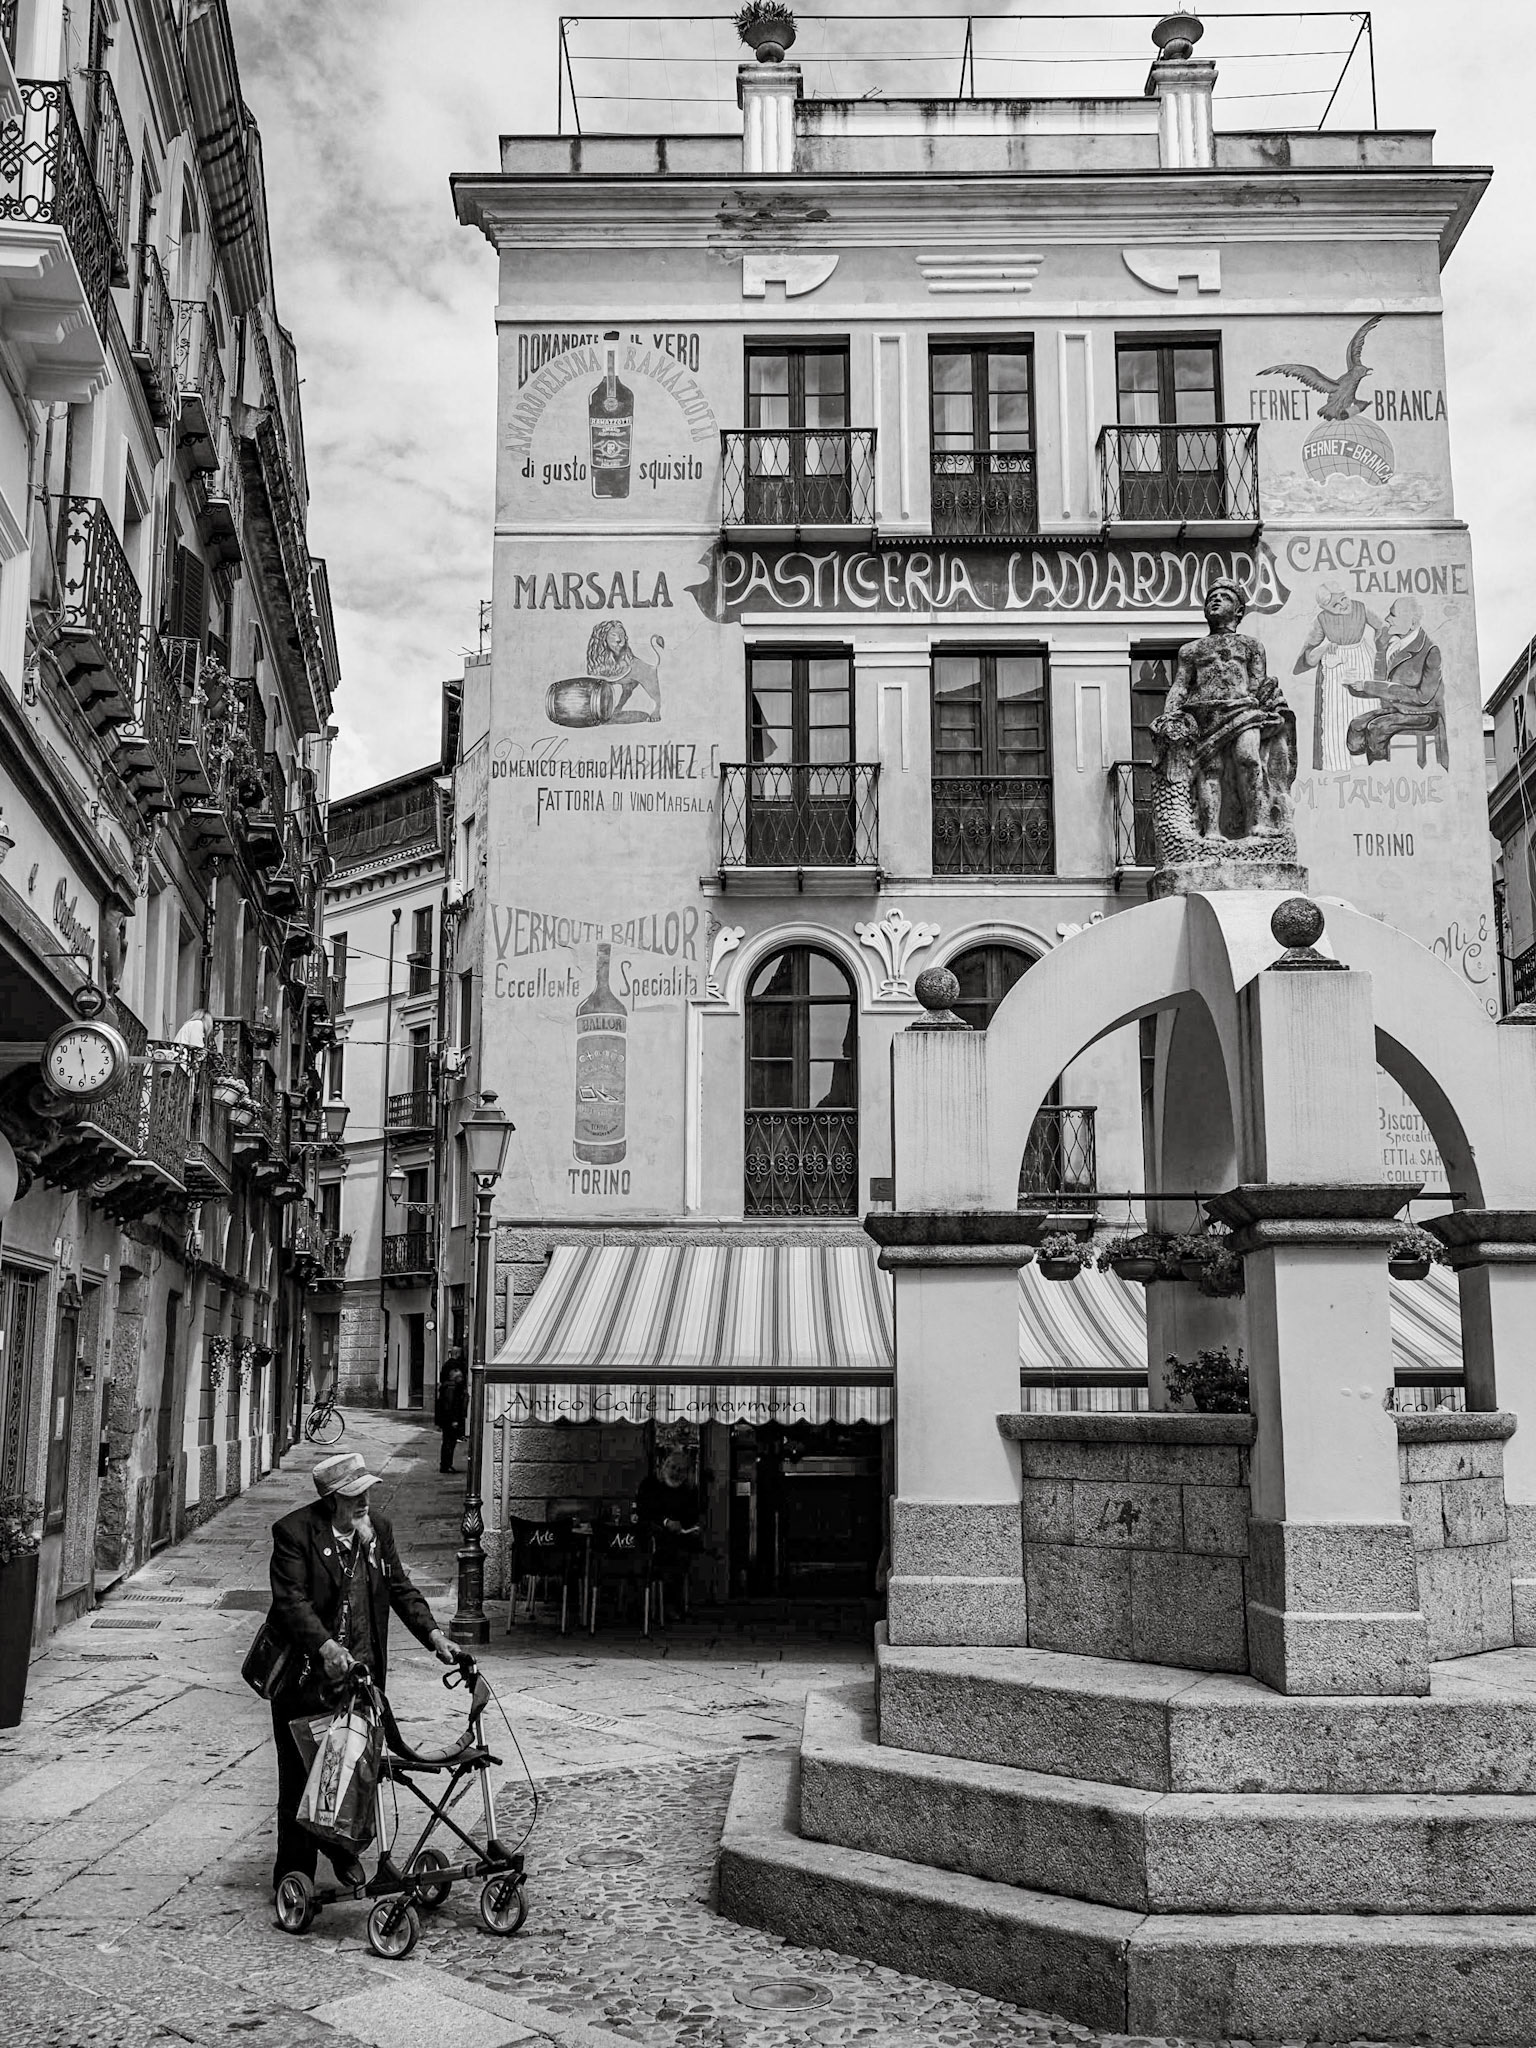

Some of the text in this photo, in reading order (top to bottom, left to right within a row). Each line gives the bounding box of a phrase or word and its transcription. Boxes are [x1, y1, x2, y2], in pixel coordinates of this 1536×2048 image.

[518, 333, 700, 390] DOMANDATE IL VERO
[505, 347, 602, 457] AMARO FELSINA
[623, 346, 719, 443] RAMAZZOTTI
[1250, 389, 1448, 422] FERNET BRANCA
[521, 454, 703, 489] di gusto squisito
[1303, 439, 1394, 483] FERNET-BRANCA
[1286, 535, 1396, 573] CACAO
[513, 570, 674, 610] MARSALA
[716, 550, 1285, 615] PASTICCERIA LAMARMORA
[1349, 563, 1469, 595] TALMONE
[492, 760, 556, 779] DOMENICO
[560, 761, 607, 779] FLORIO
[609, 744, 698, 780] MARTINEZ
[1333, 774, 1444, 810] TALMONE
[537, 787, 714, 827] FATTORIA DI VINO MARSALA
[1353, 833, 1415, 857] TORINO
[490, 904, 699, 961] VERMOUTH BALLOR
[495, 962, 581, 998] Eccellente
[583, 1018, 622, 1031] BALLOR
[58, 1045, 68, 1054] 10
[69, 1037, 76, 1045] 11
[80, 1033, 89, 1043] 12
[93, 1037, 97, 1045] 1
[100, 1044, 108, 1054] 2
[56, 1055, 62, 1065] 9
[59, 1067, 65, 1076] 8
[98, 1067, 105, 1076] 4
[103, 1055, 110, 1065] 3
[67, 1075, 73, 1085] 7
[78, 1078, 85, 1088] 6
[90, 1075, 96, 1085] 5
[1382, 1148, 1408, 1165] ETTI
[568, 1168, 631, 1195] TORINO
[504, 1392, 584, 1413] Antico
[666, 1393, 807, 1413] Lamarmora
